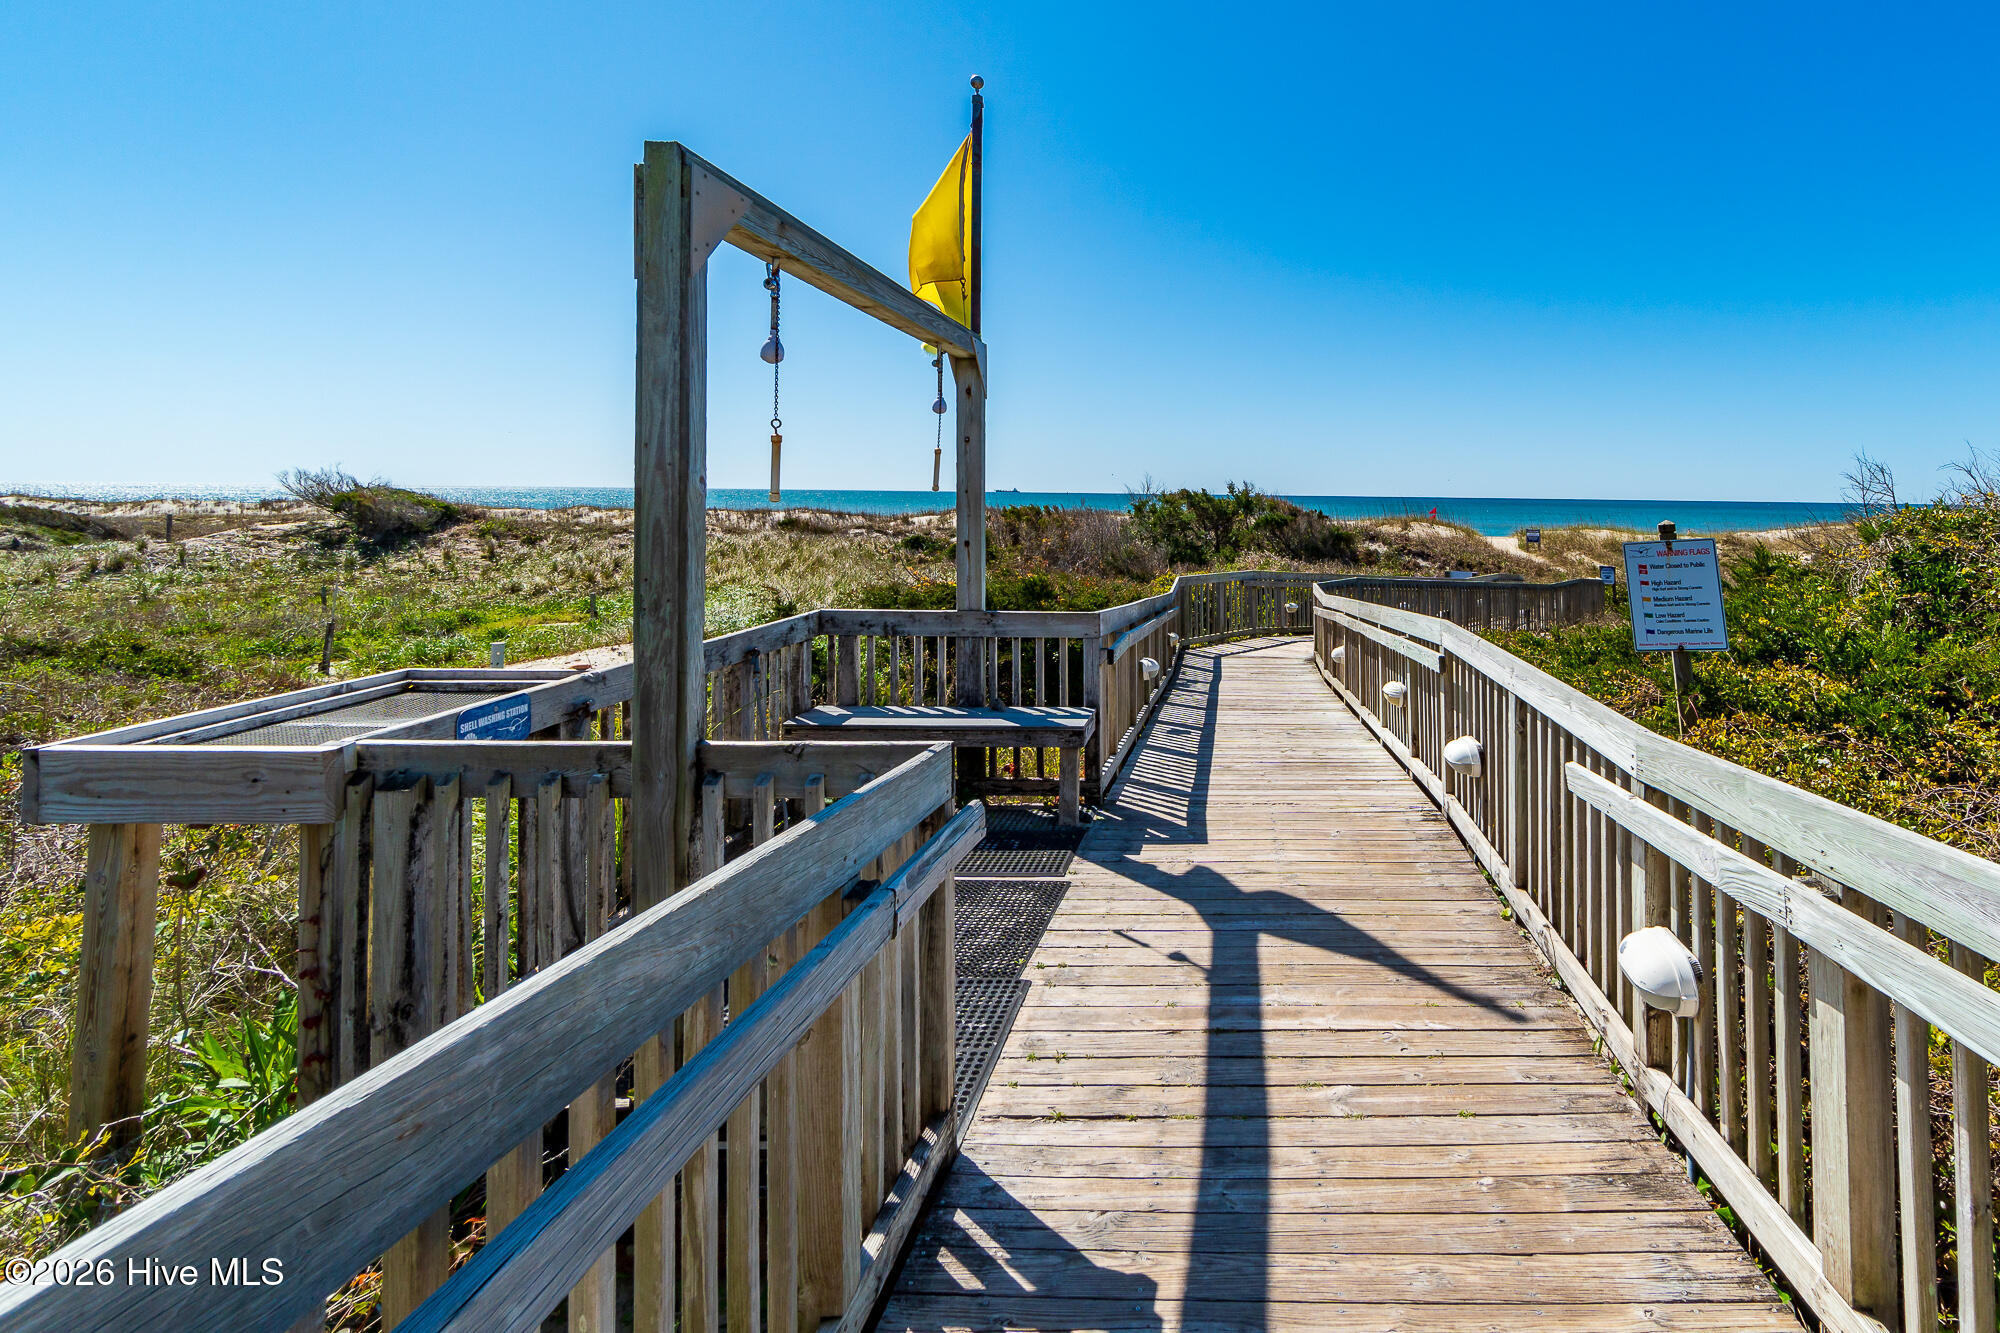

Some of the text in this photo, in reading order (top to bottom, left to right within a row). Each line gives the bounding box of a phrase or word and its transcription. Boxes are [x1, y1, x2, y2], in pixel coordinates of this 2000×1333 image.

[1656, 549, 1688, 558] WARNING
[460, 704, 529, 734] SHELL WASHING STATION
